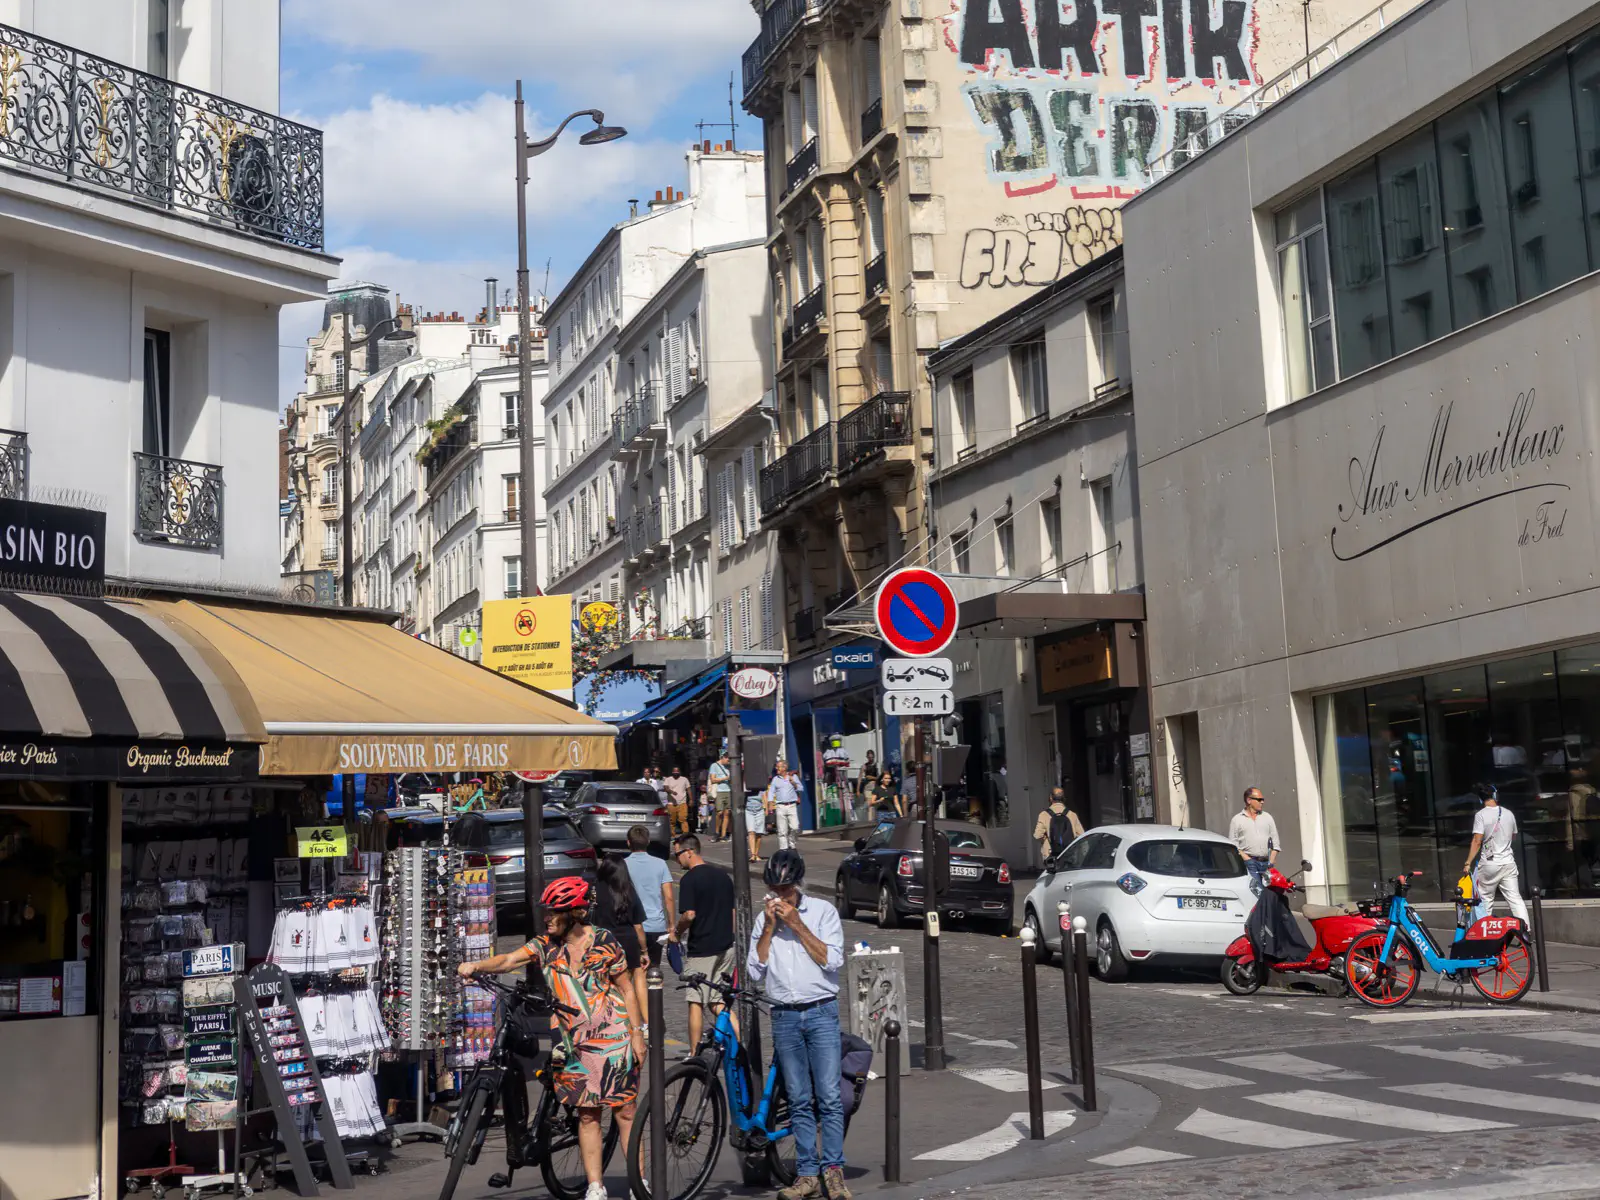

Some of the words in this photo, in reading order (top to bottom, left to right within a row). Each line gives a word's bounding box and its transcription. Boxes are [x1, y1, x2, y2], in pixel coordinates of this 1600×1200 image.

[1338, 424, 1399, 522] Aux
[1405, 388, 1566, 502] Merveilleux
[1518, 519, 1530, 548] de
[1532, 500, 1568, 543] Fred
[0, 524, 44, 564] SIN
[55, 531, 96, 570] BIO
[492, 643, 524, 654] INTERDICTION
[531, 641, 561, 651] STATIONNER
[0, 744, 17, 763] ier
[20, 742, 58, 765] Paris
[127, 745, 172, 773] Organic
[174, 745, 234, 768] Buckweat
[340, 743, 428, 769] SOUVENIR
[434, 743, 457, 767] DE
[464, 743, 509, 767] PARIS
[310, 829, 335, 842] 4€
[314, 846, 324, 854] for
[1182, 898, 1222, 909] FC-967-SZ
[1410, 929, 1429, 955] dott
[192, 952, 222, 965] PARIS
[185, 965, 191, 973] F
[252, 981, 282, 996] MUSIC
[207, 1012, 228, 1021] EIFFEL
[199, 1022, 220, 1030] PARIS
[244, 1009, 269, 1064] MUSIC
[200, 1044, 221, 1052] AVENUE
[190, 1055, 211, 1064] CHAMPS
